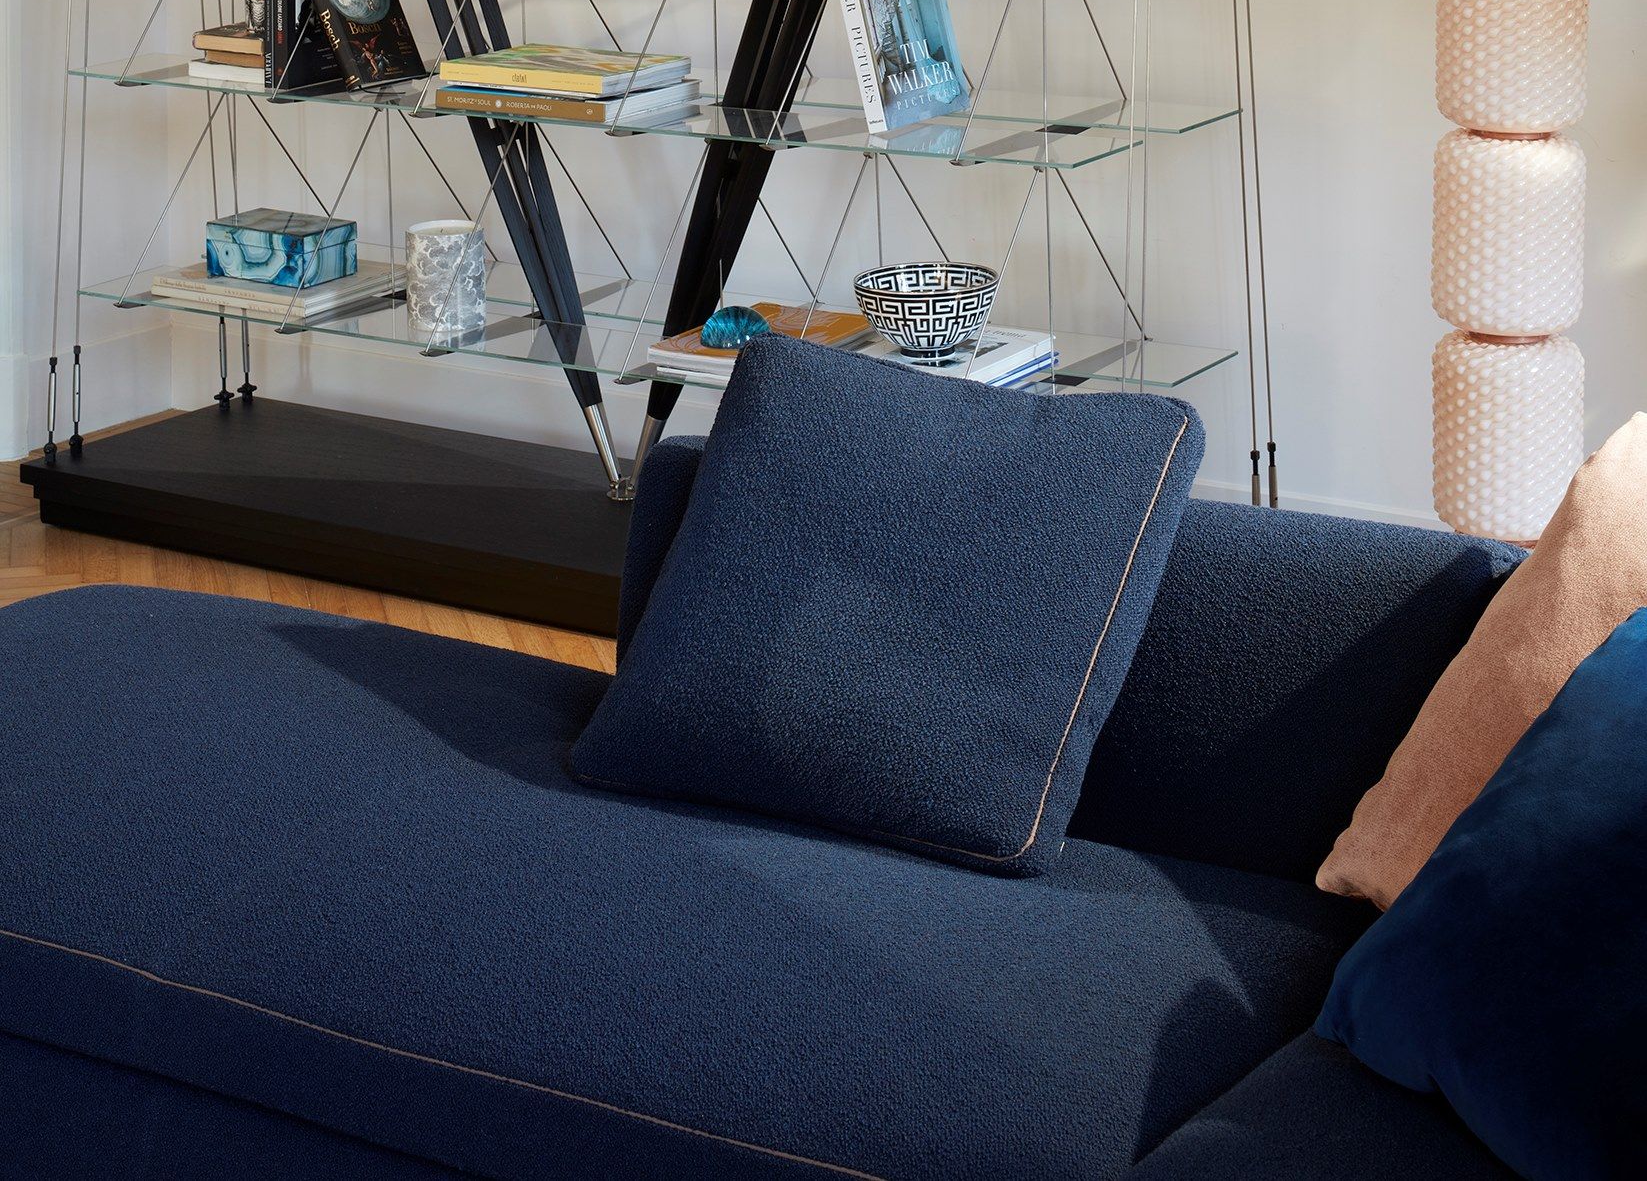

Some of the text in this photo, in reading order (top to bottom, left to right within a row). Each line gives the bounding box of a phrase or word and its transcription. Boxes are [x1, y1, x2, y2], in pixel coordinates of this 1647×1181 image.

[320, 8, 341, 50] Bosch
[851, 26, 876, 105] PICTURES
[900, 39, 930, 65] TIM
[887, 61, 954, 95] WALKER
